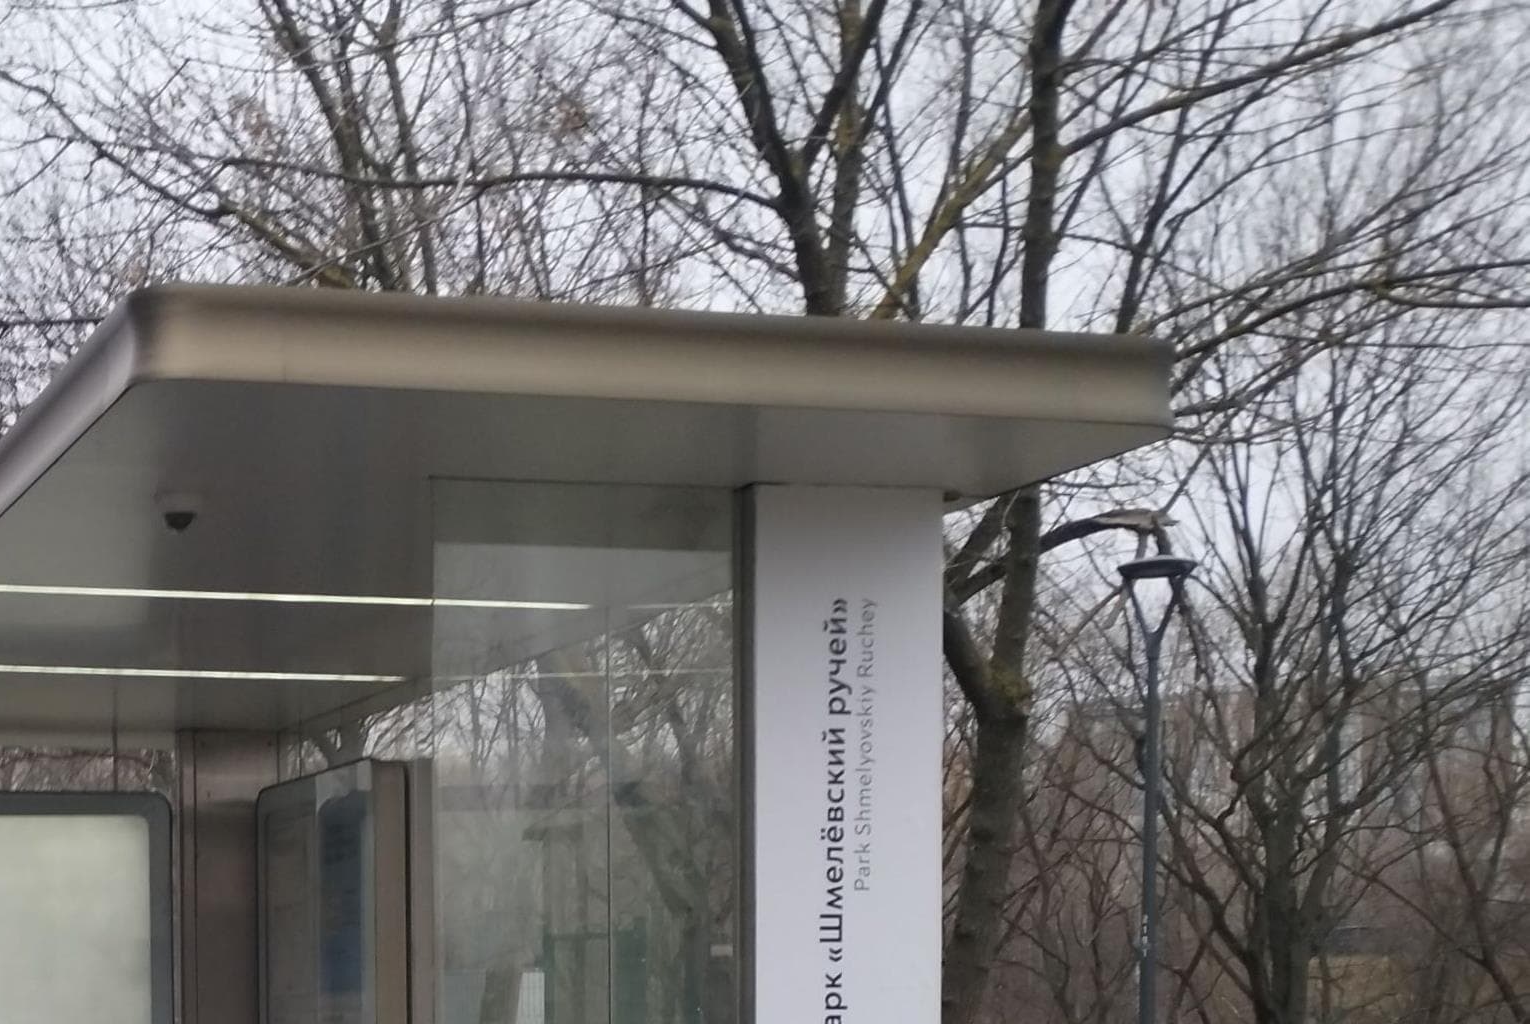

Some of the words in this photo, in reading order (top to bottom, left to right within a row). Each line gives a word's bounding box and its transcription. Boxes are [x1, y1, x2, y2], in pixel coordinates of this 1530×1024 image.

[822, 598, 853, 716] ручей»
[856, 598, 878, 679] Ruchey
[853, 685, 877, 838] Shmelyovskiy
[818, 727, 846, 964] «Шмелёвский
[853, 841, 872, 892] Park
